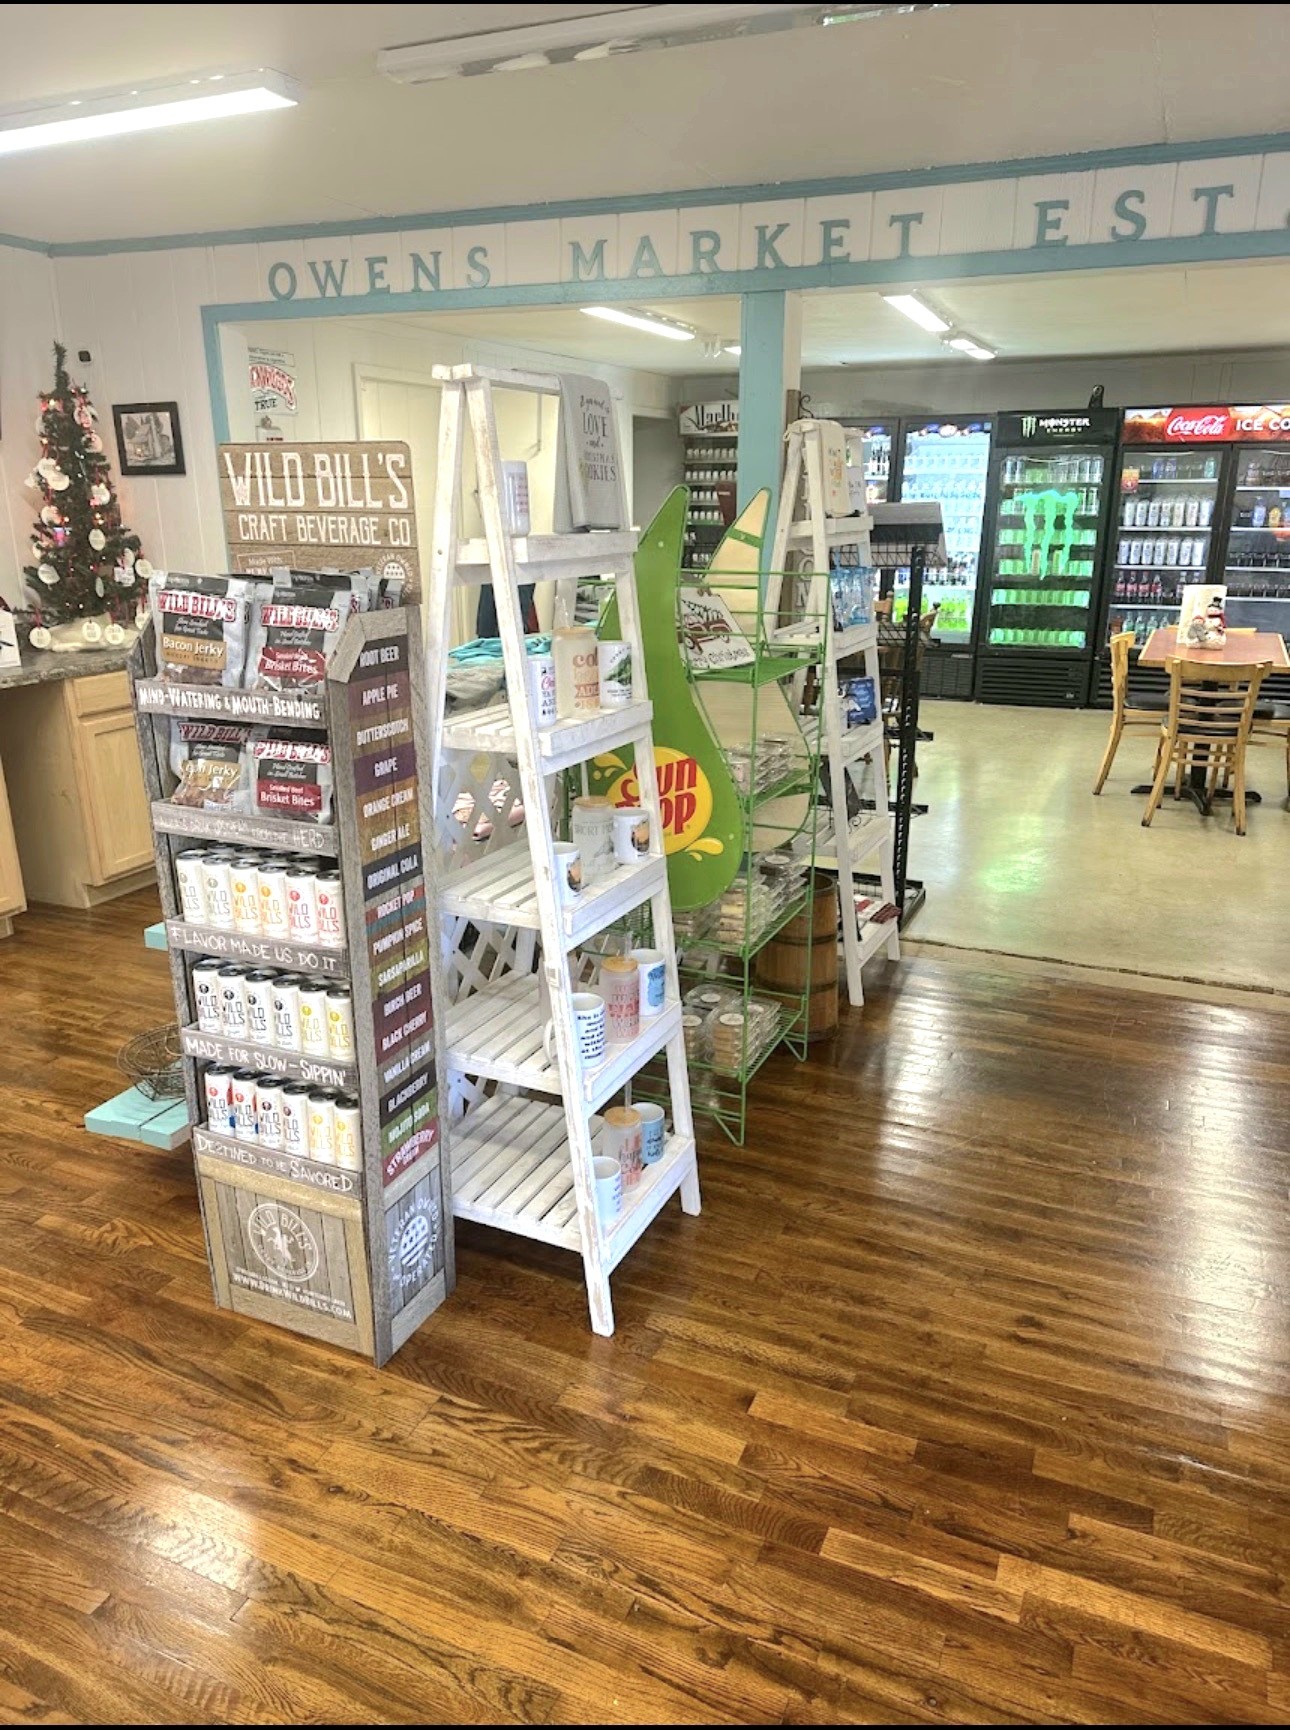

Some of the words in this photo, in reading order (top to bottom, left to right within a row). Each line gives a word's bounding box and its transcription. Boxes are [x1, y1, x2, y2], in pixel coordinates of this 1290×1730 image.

[267, 245, 491, 301] OWENS
[569, 212, 924, 282] MARKET
[583, 412, 608, 437] LOVE
[1038, 417, 1090, 428] MONSTER
[1167, 414, 1229, 436] Coca-Cola
[1236, 419, 1264, 431] ICE
[223, 452, 305, 507] WILD
[313, 452, 409, 509] BILL'S
[238, 514, 287, 542] CRAFT
[296, 515, 382, 545] BEVERAGE
[388, 518, 411, 546] CO
[162, 637, 193, 651] Bacon
[194, 641, 223, 657] Jerky
[359, 647, 379, 668] ROOT
[380, 645, 400, 664] BEER
[139, 687, 221, 710] MIND-WATERING
[232, 696, 320, 720] MOUTH-BENDING
[362, 686, 387, 706] APPLE
[387, 683, 399, 700] PIE
[356, 717, 409, 746] BUTTERSCOTCH
[207, 764, 237, 777] Jerky
[374, 757, 398, 778] GRAPE
[260, 791, 291, 805] Brisket
[291, 794, 315, 807] Bites
[363, 796, 391, 818] ORANGE
[391, 787, 413, 808] CREAM
[293, 828, 325, 849] HERD
[371, 828, 397, 851] GINGER
[397, 823, 410, 841] ALE
[367, 865, 400, 890] ORIGINAL
[400, 854, 418, 874] COLA
[377, 896, 401, 919] ROCKET
[401, 890, 415, 907] POP
[170, 927, 227, 951] FLAVOR
[230, 938, 271, 960] MADE
[275, 946, 293, 963] US
[298, 953, 319, 968] DO
[322, 957, 337, 970] IT
[373, 927, 404, 956] PUMPKIN
[404, 917, 424, 938] SPICE
[378, 949, 425, 987] SARSAPARILLA
[405, 983, 422, 1004] BEER
[382, 1027, 403, 1051] BLACK
[403, 1010, 427, 1037] CHERRY
[185, 1037, 223, 1060] MADE
[229, 1047, 250, 1063] FOR
[383, 1055, 410, 1084] VANILLA
[410, 1040, 431, 1065] CREAM
[387, 1072, 429, 1113] BLACKBERRY
[196, 1133, 256, 1164] DESTINED
[261, 1157, 274, 1168] TO
[289, 1158, 353, 1192] SAVORED
[386, 1128, 434, 1176] STRAWBERRY
[253, 1210, 277, 1237] WILD
[388, 1202, 415, 1264] VETERAN
[417, 1197, 439, 1223] OWNED
